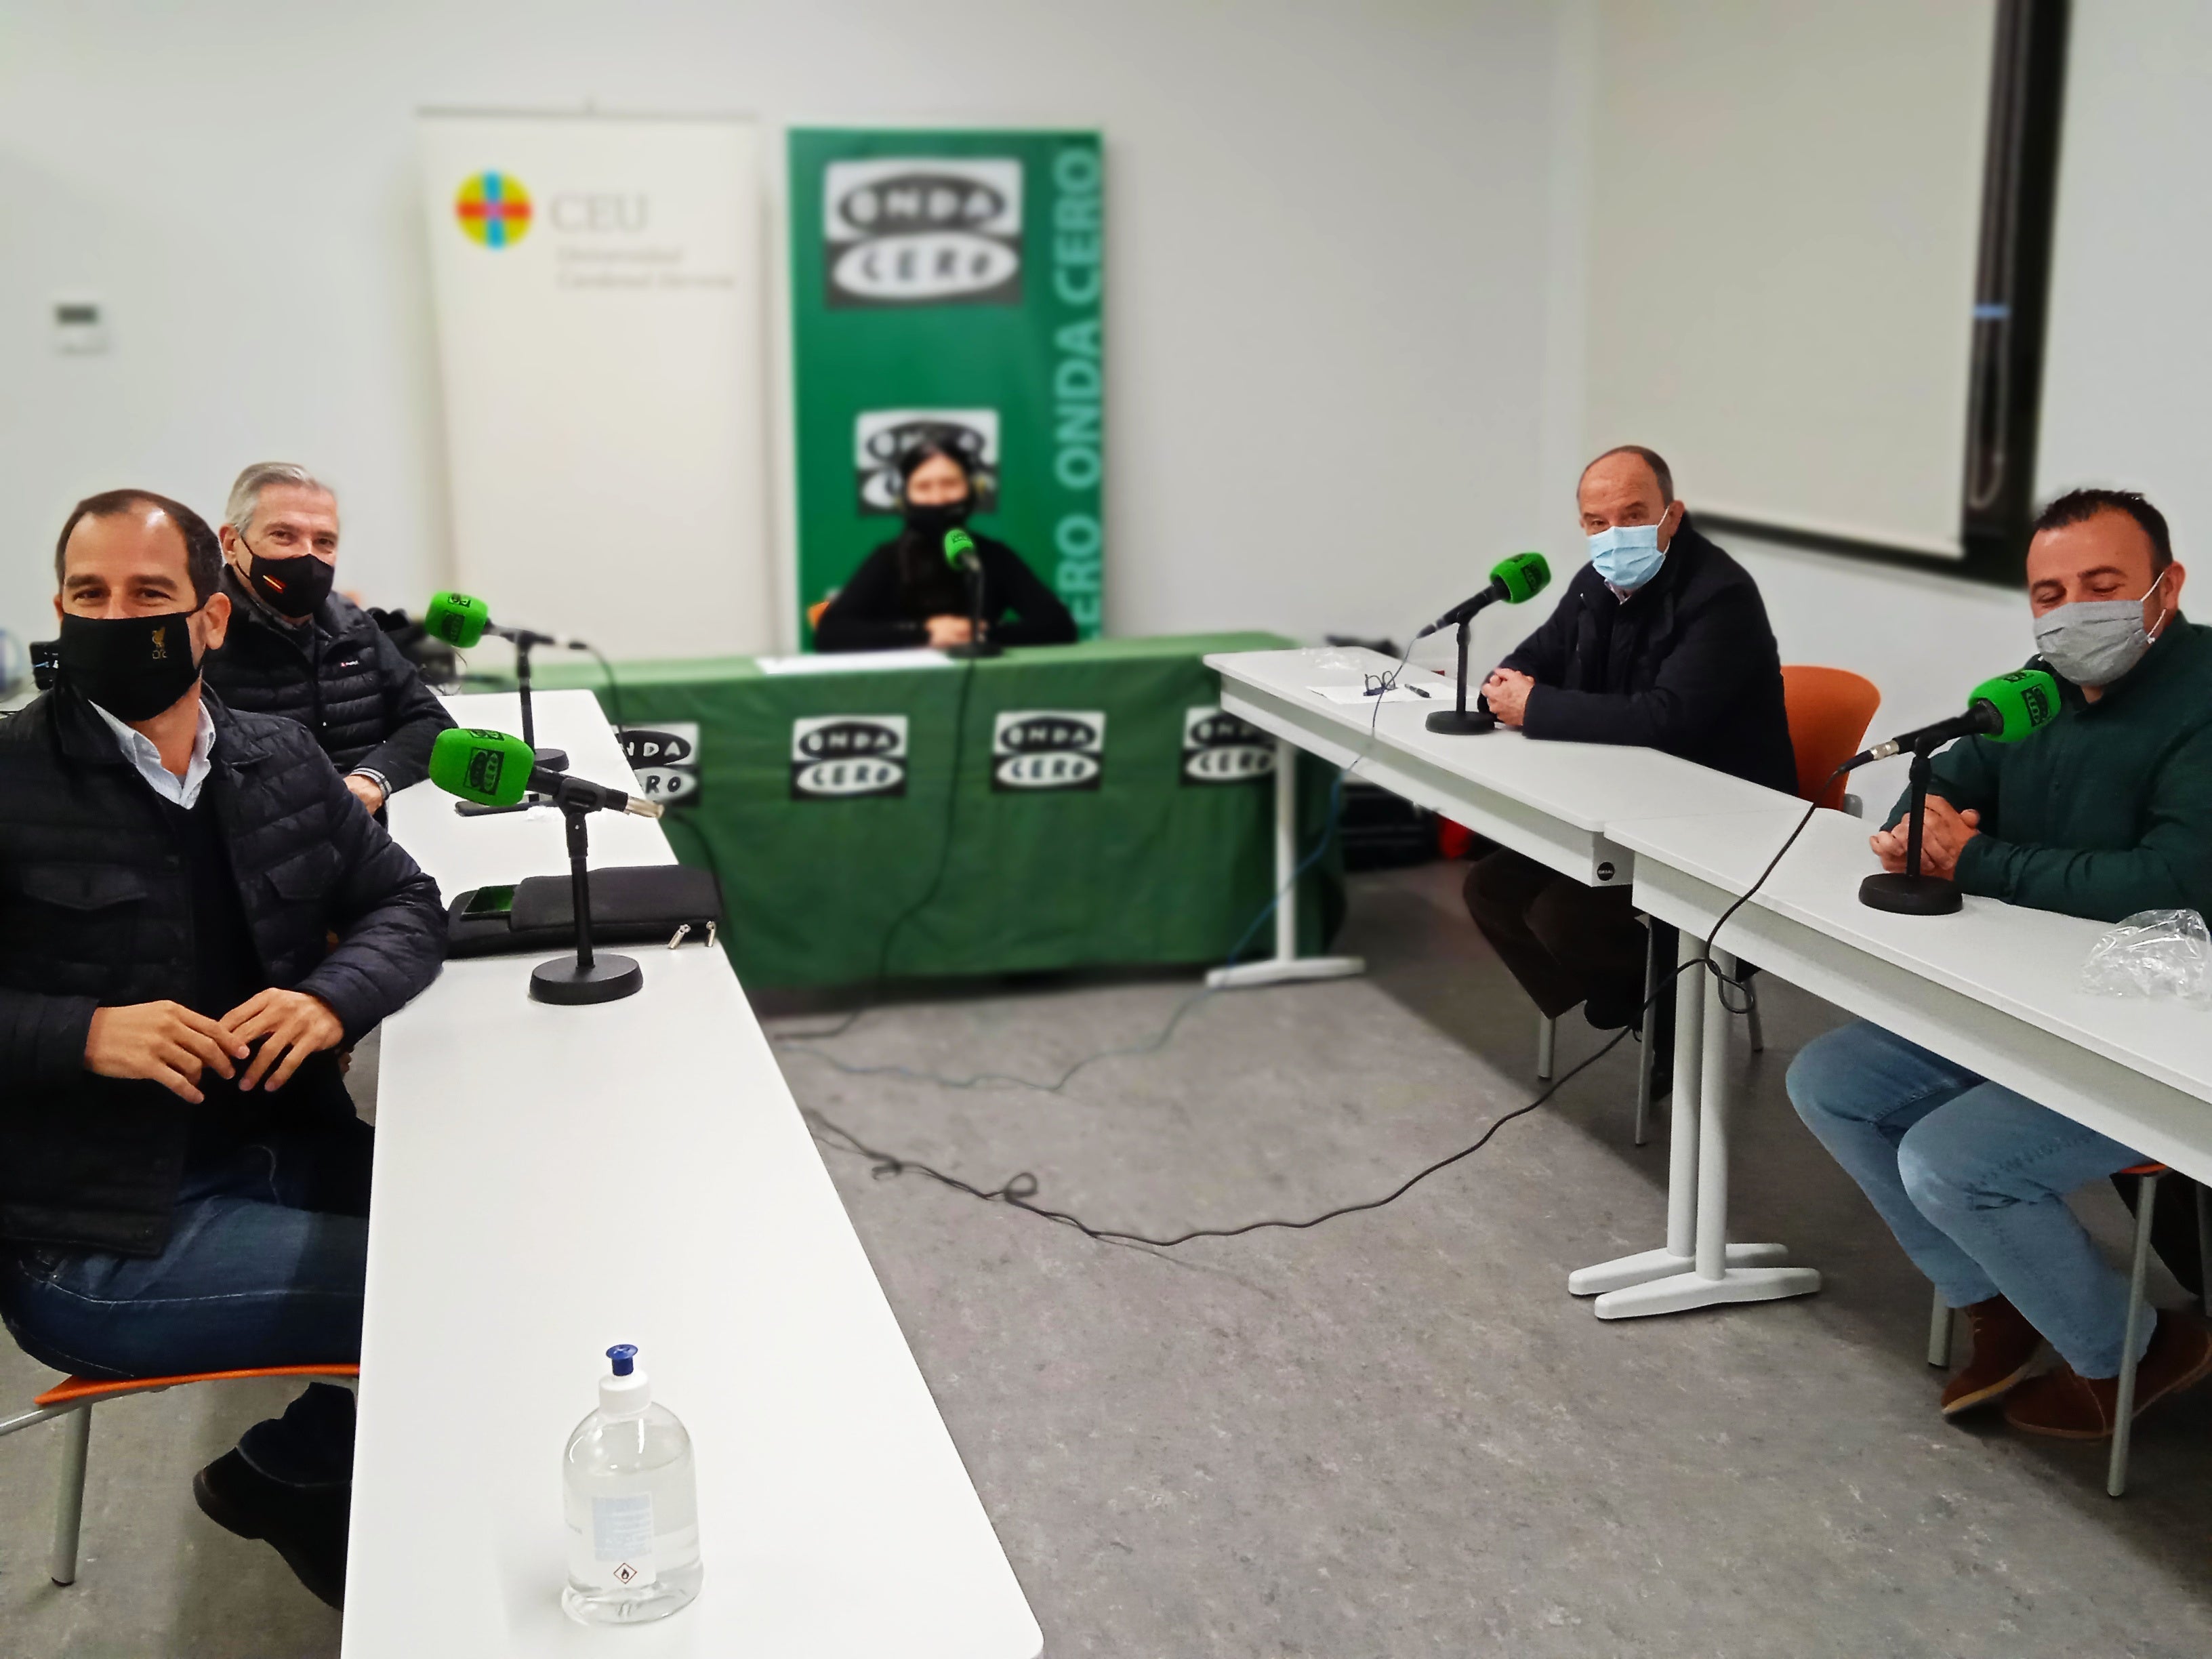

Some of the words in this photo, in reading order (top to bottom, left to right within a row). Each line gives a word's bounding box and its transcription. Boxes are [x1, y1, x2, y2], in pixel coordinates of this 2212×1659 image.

[548, 192, 649, 232] CEU
[849, 188, 994, 225] ONDA
[1054, 147, 1101, 306] CERO
[862, 248, 991, 283] CERO
[1055, 321, 1101, 491] ONDA
[1055, 513, 1101, 637] ERO
[619, 741, 681, 756] NDA
[808, 731, 890, 751] ONDA
[1007, 724, 1088, 745] ONDA
[813, 764, 890, 786] CERO
[1010, 758, 1086, 779] CERO
[645, 775, 681, 793] RO
